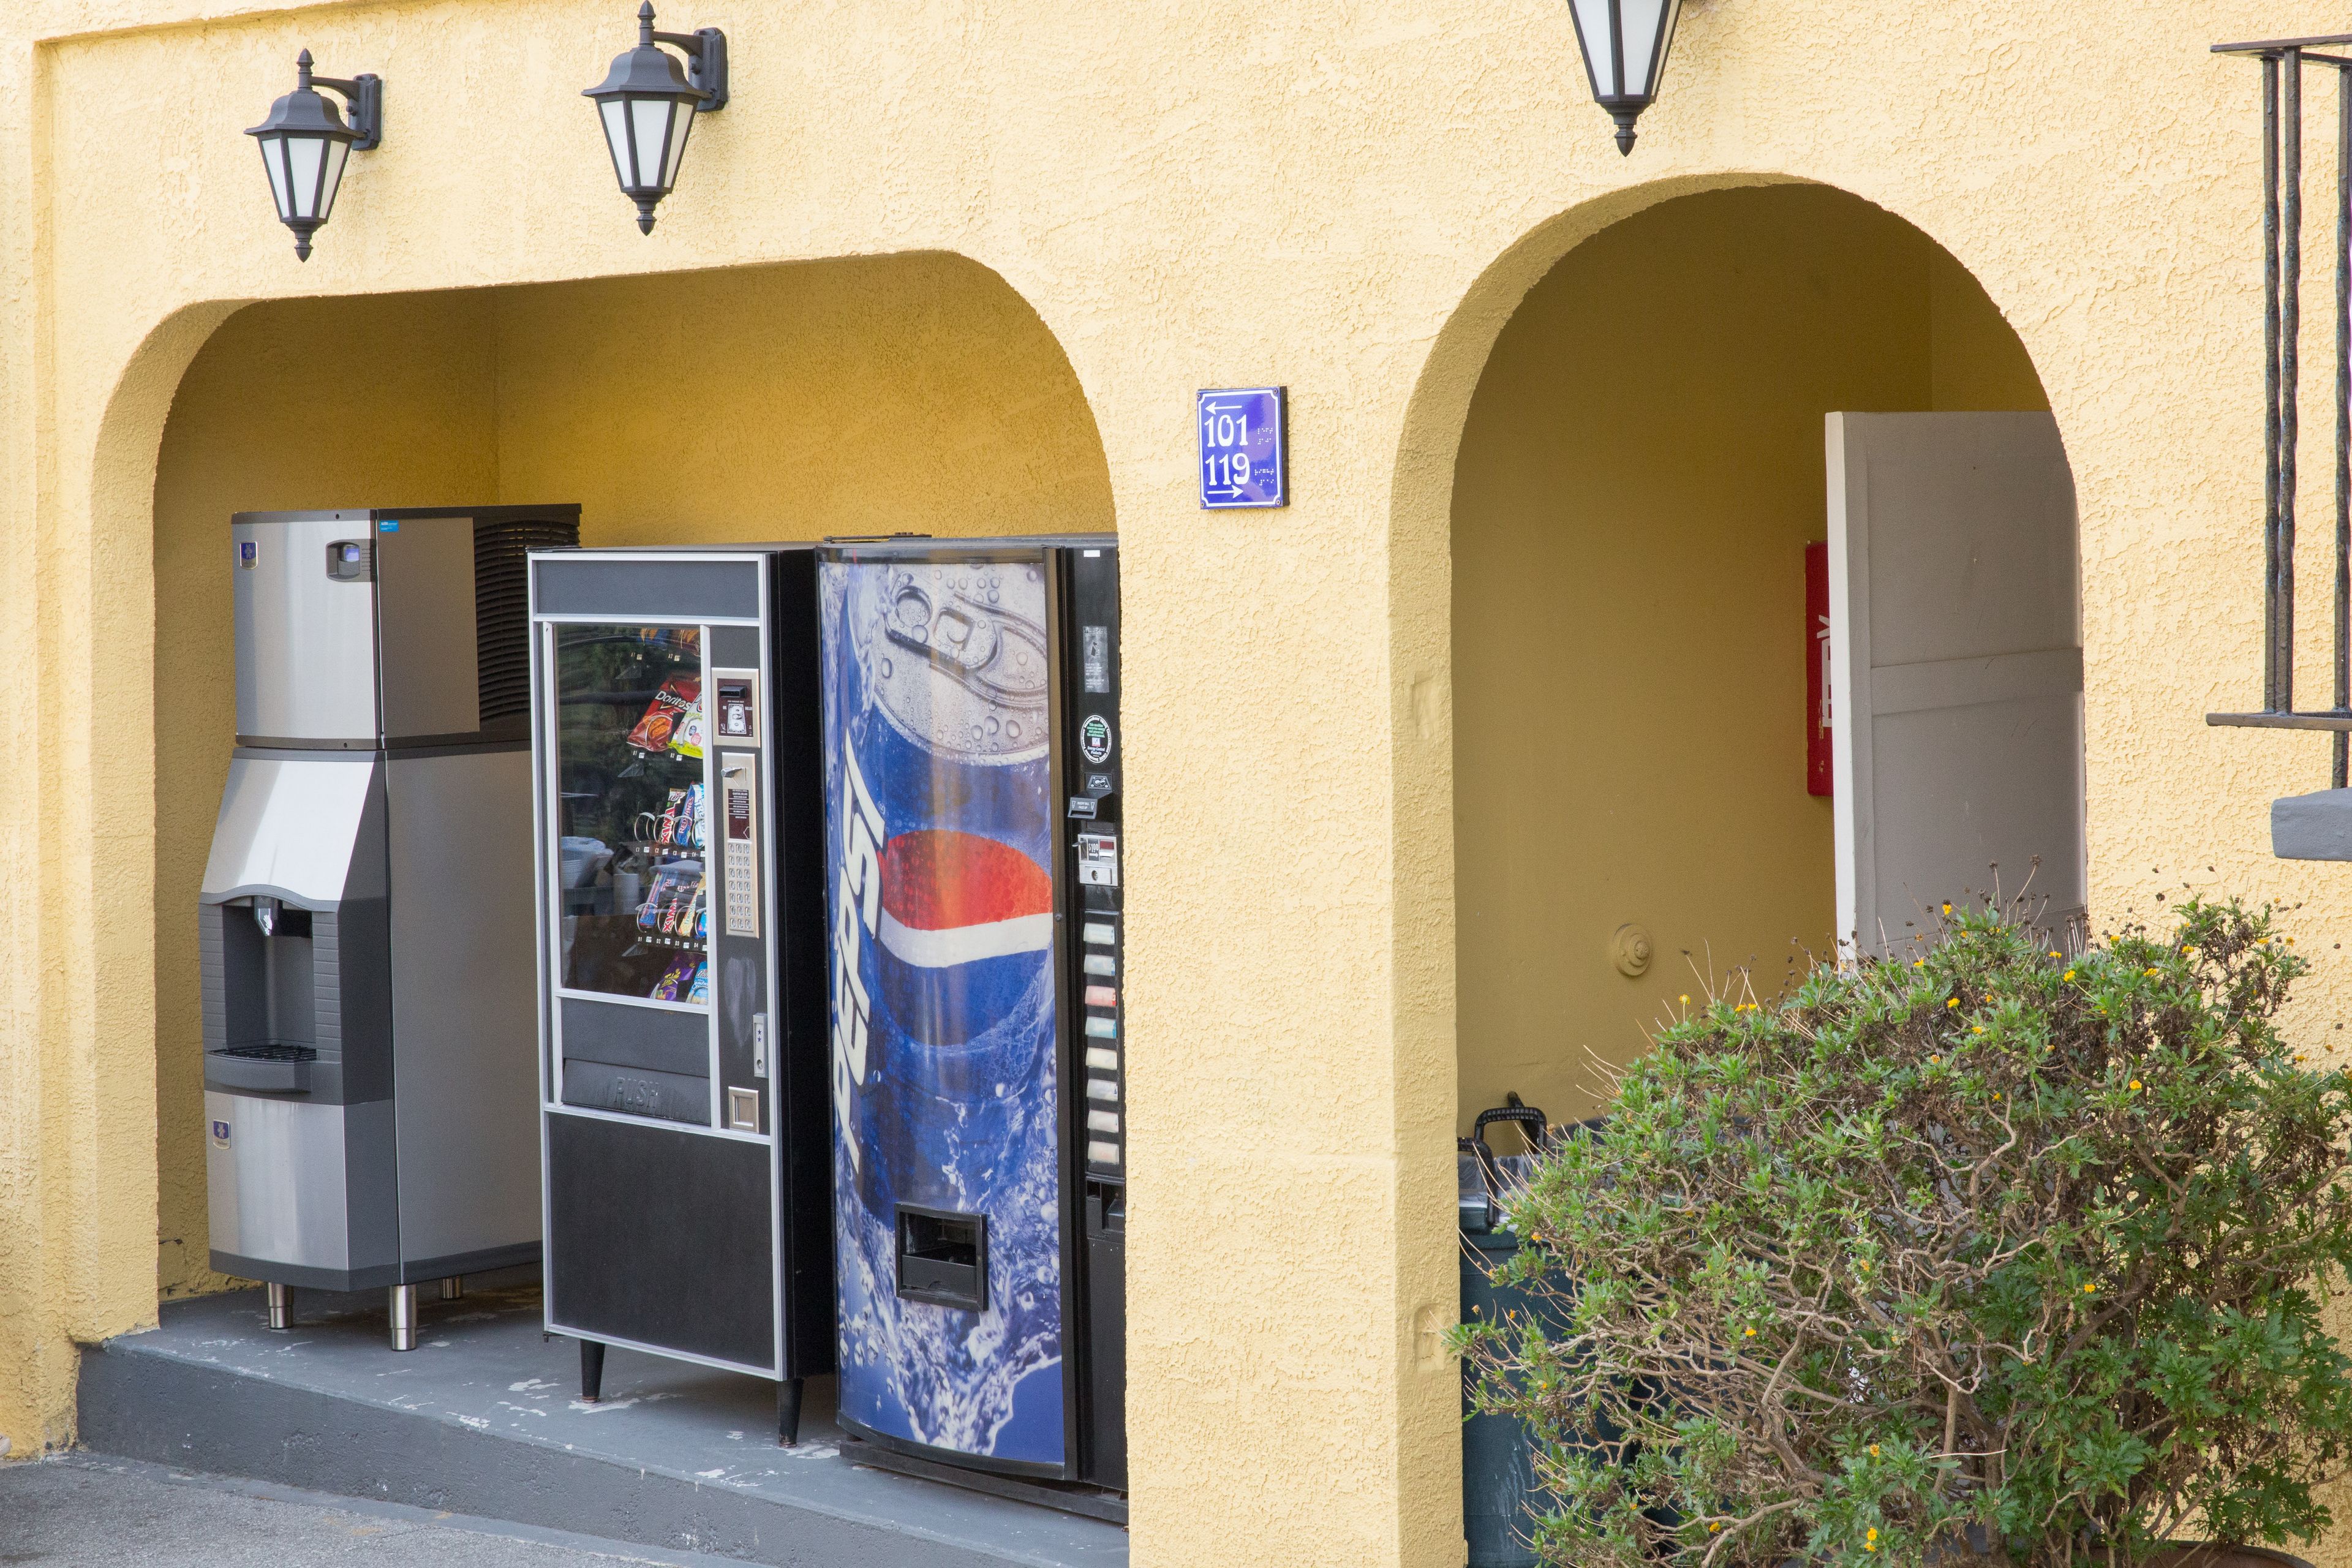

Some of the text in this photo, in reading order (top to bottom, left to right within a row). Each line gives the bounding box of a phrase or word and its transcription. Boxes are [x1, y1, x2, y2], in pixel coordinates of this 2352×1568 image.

[1204, 414, 1248, 447] 101
[1205, 453, 1250, 486] 119
[655, 690, 692, 711] Doritos
[679, 819, 688, 834] RED
[833, 727, 886, 1175] PEPSI
[614, 1077, 659, 1108] PUSH
